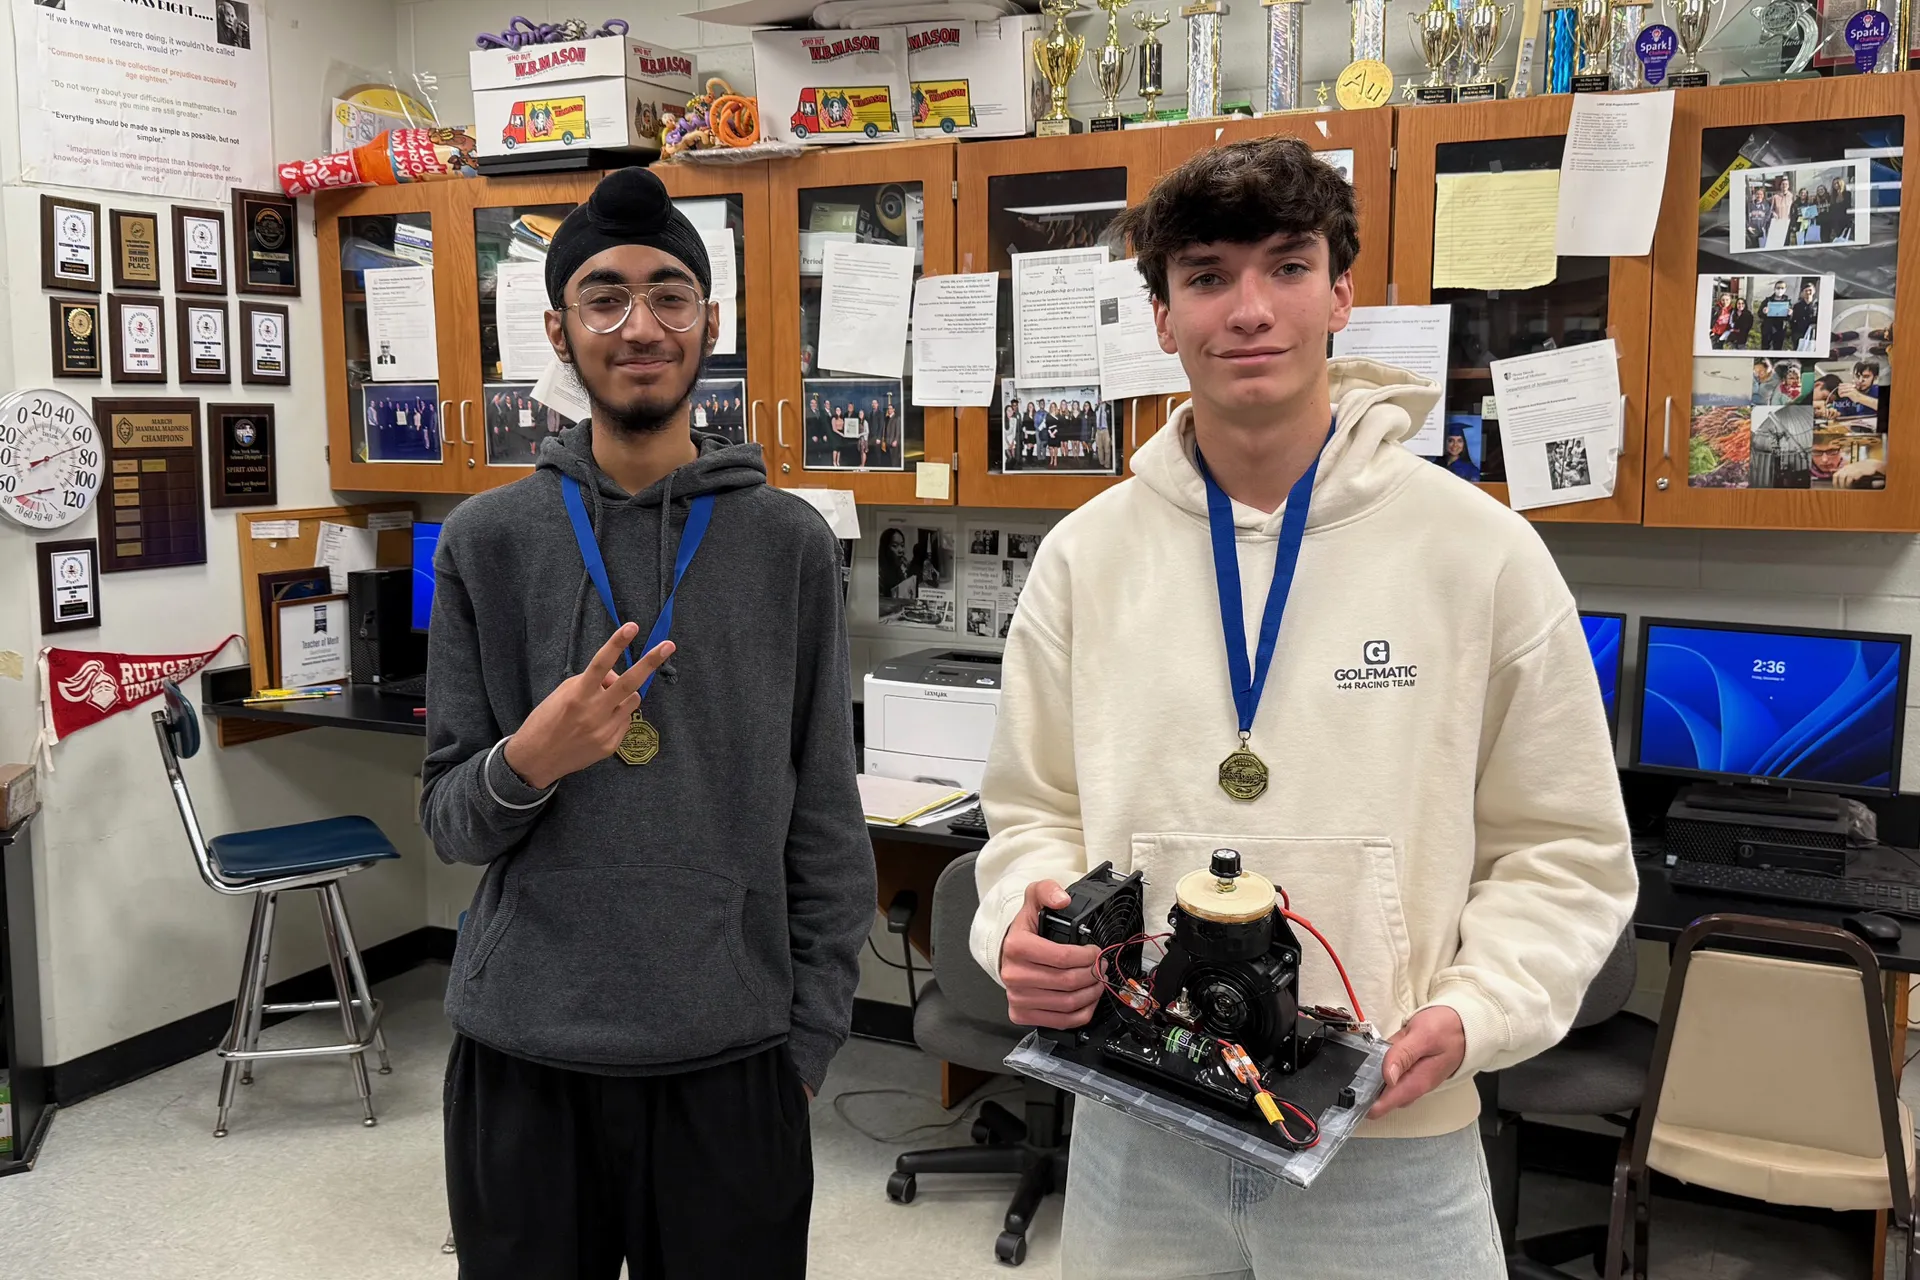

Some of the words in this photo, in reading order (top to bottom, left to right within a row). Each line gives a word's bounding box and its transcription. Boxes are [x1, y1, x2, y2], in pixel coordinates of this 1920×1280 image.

[69, 17, 90, 28] knew
[92, 23, 111, 32] what
[113, 27, 123, 35] we
[125, 30, 143, 38] were
[145, 32, 168, 44] doing,
[169, 36, 174, 45] it
[216, 47, 235, 57] called
[1850, 22, 1885, 40] Spark!
[110, 37, 145, 51] research,
[147, 45, 168, 54] would
[1640, 36, 1672, 53] Spark!
[85, 54, 106, 64] sense
[107, 57, 114, 65] is
[115, 59, 126, 67] the
[127, 61, 160, 73] collection
[170, 70, 201, 81] prejudices
[203, 75, 228, 86] acquired
[514, 47, 586, 78] W.B.MASON
[125, 71, 138, 80] age
[66, 82, 78, 90] not
[80, 85, 100, 94] worry
[101, 88, 121, 97] about
[122, 92, 138, 100] your
[140, 93, 174, 104] difficulties
[1342, 69, 1383, 102] Au
[94, 98, 118, 106] assure
[119, 102, 132, 110] you
[133, 103, 150, 112] mine
[151, 106, 162, 114] are
[163, 108, 176, 116] still
[96, 118, 119, 127] should
[130, 123, 148, 132] made
[159, 126, 180, 136] simple
[182, 130, 190, 138] as
[219, 136, 229, 144] but
[53, 154, 92, 166] knowledge
[93, 158, 100, 166] is
[101, 158, 124, 169] limited
[126, 162, 142, 171] while
[144, 164, 182, 176] imagination
[183, 170, 213, 180] embraces
[120, 152, 136, 160] more
[138, 154, 170, 166] important
[171, 158, 186, 166] than
[1708, 190, 1719, 200] 10
[128, 262, 150, 270] PLACE
[32, 399, 52, 418] 20
[1833, 400, 1851, 408] hack
[17, 406, 28, 424] 0
[55, 406, 74, 424] 40
[72, 426, 92, 444] 60
[142, 434, 184, 442] CHAMPIONS
[78, 448, 98, 468] 80
[74, 470, 96, 489] 100
[63, 490, 86, 508] 120
[14, 504, 24, 514] 70
[24, 510, 32, 519] 60
[32, 512, 42, 522] 50
[43, 512, 52, 522] 40
[56, 510, 66, 520] 30
[302, 640, 320, 649] Teacher
[322, 637, 326, 646] of
[327, 636, 339, 645] Merit
[1365, 642, 1387, 662] G
[1334, 665, 1418, 681] GOLFMATIC
[1752, 658, 1786, 674] 2:36
[1337, 682, 1352, 690] +44
[1354, 680, 1389, 689] RACING
